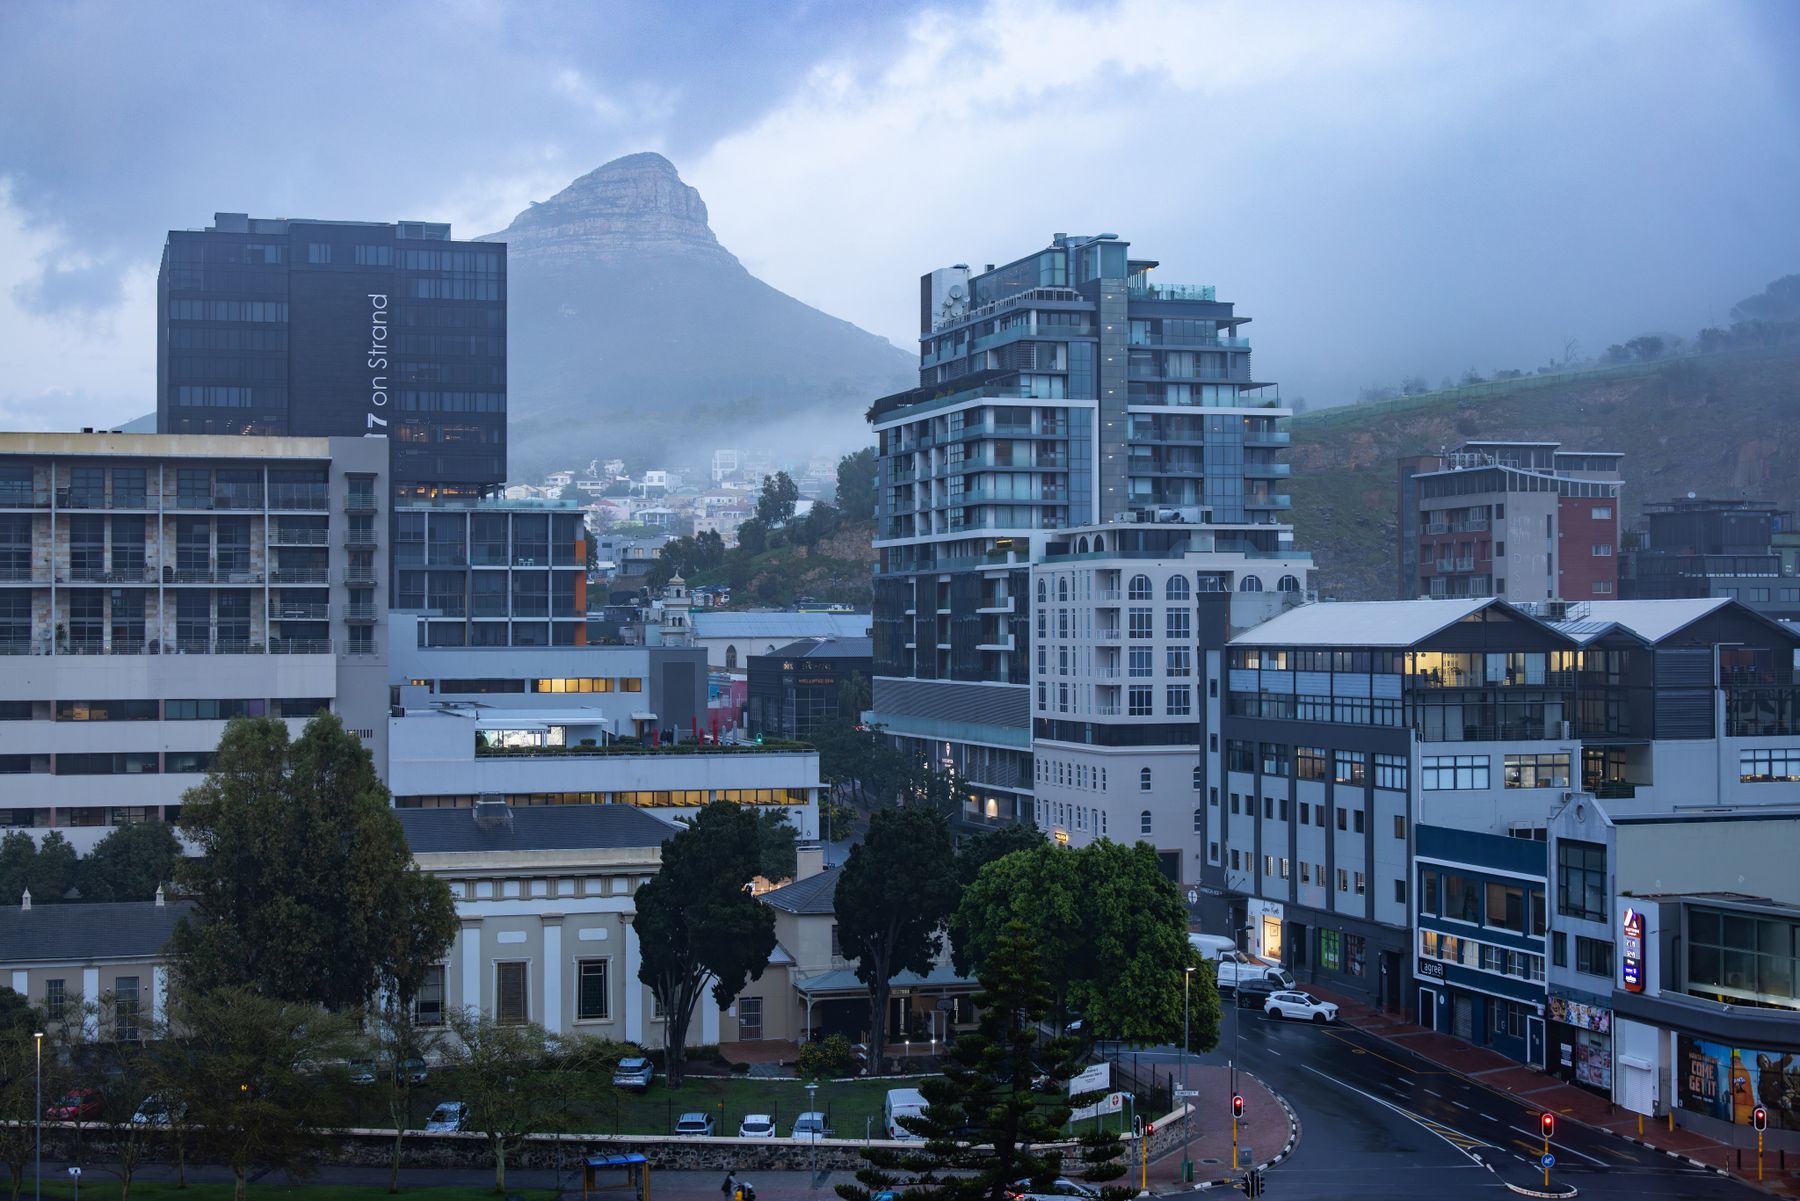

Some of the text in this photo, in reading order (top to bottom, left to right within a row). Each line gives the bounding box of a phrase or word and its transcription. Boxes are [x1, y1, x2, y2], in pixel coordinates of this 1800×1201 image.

[367, 294, 388, 369] Strand
[372, 376, 388, 406] on
[1691, 1060, 1714, 1079] COME
[1688, 1075, 1717, 1097] GET IT
